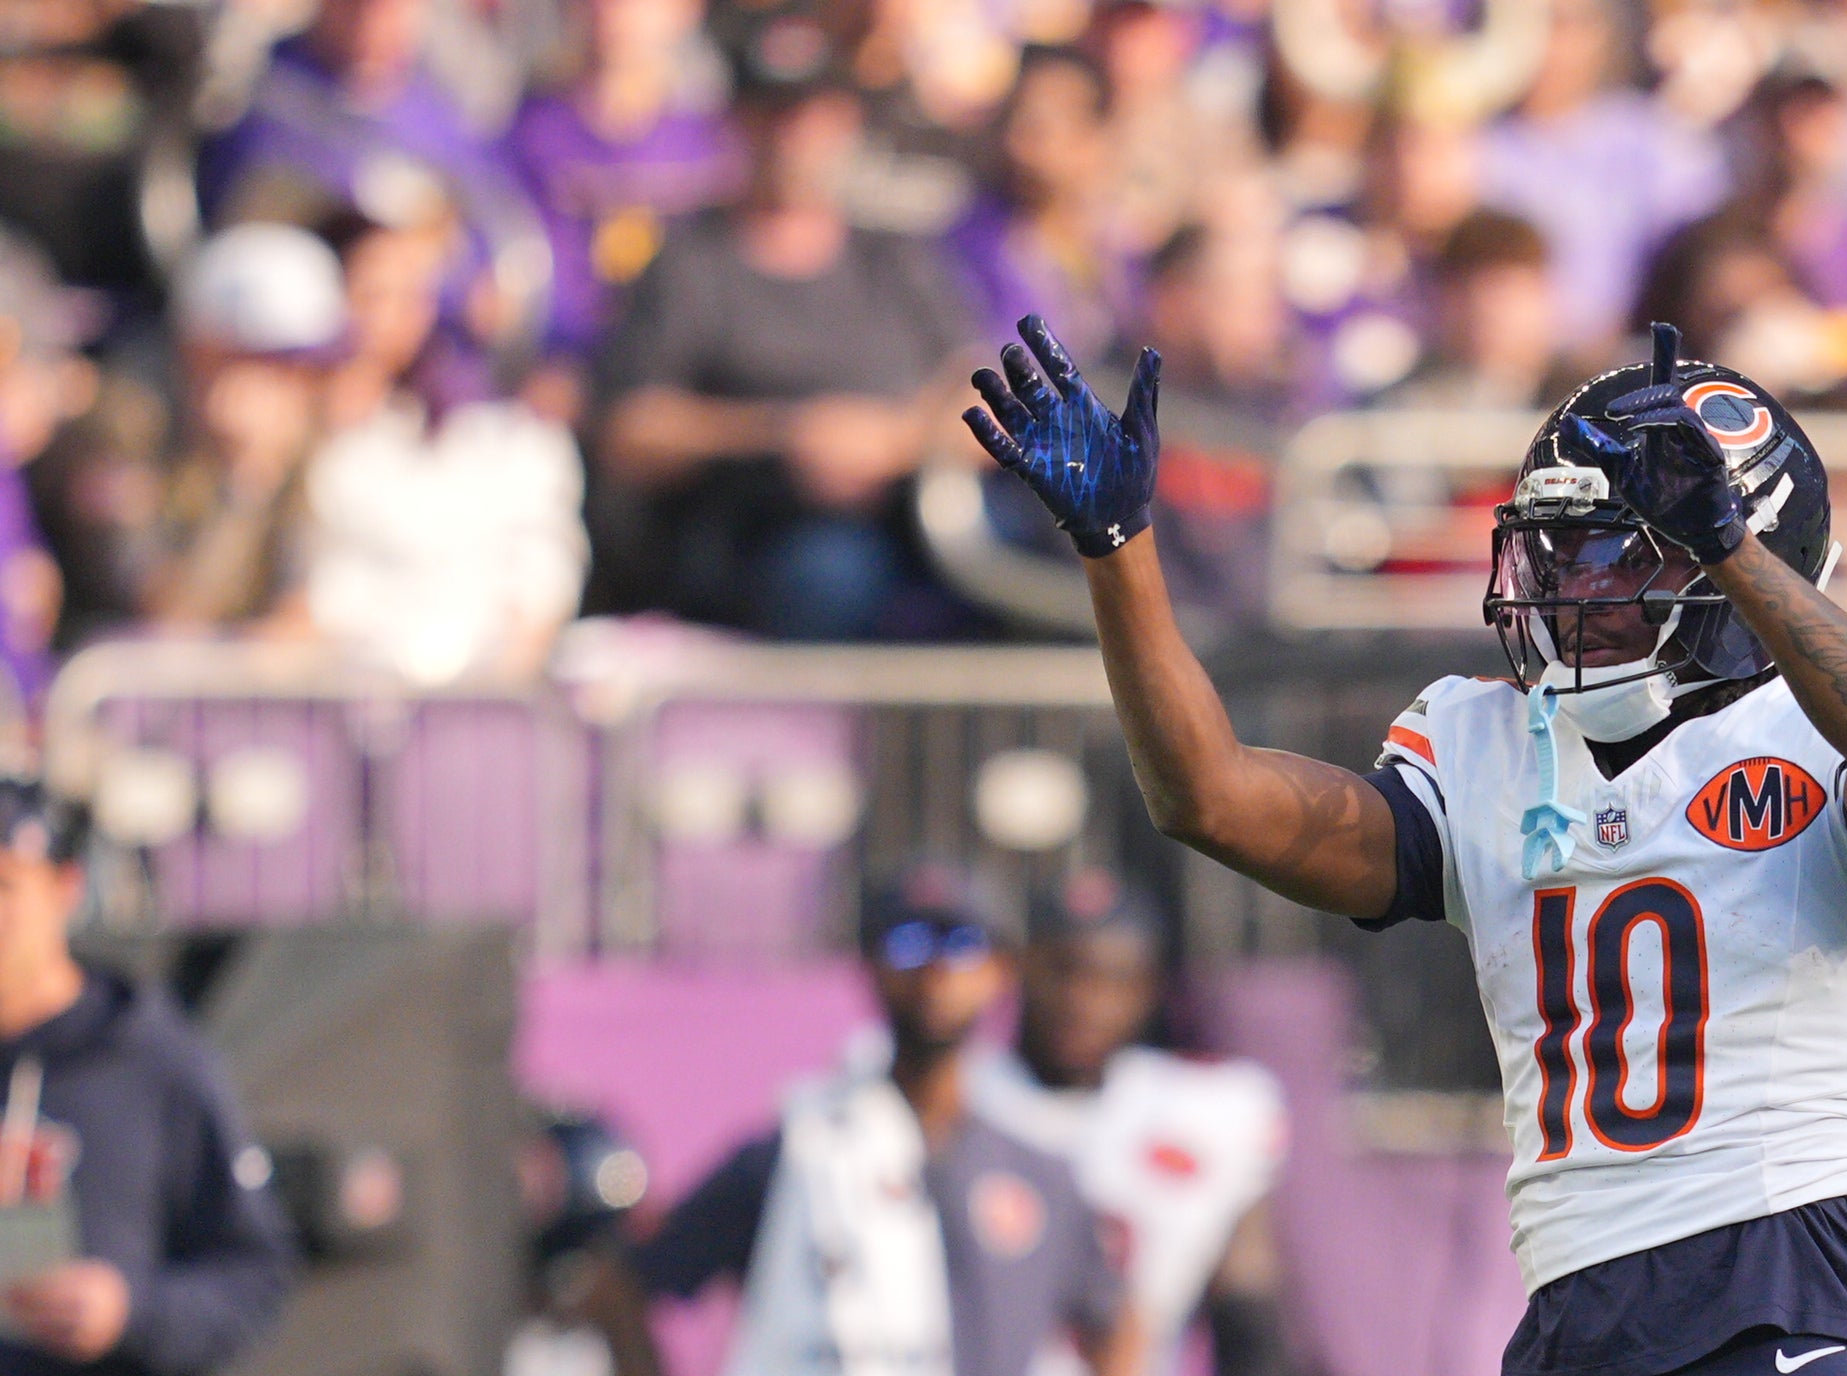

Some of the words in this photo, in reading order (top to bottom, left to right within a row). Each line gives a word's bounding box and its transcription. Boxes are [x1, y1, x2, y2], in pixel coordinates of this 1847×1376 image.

[1600, 824, 1626, 843] NFL
[1703, 764, 1809, 842] VMH
[1532, 876, 1710, 1163] 10
